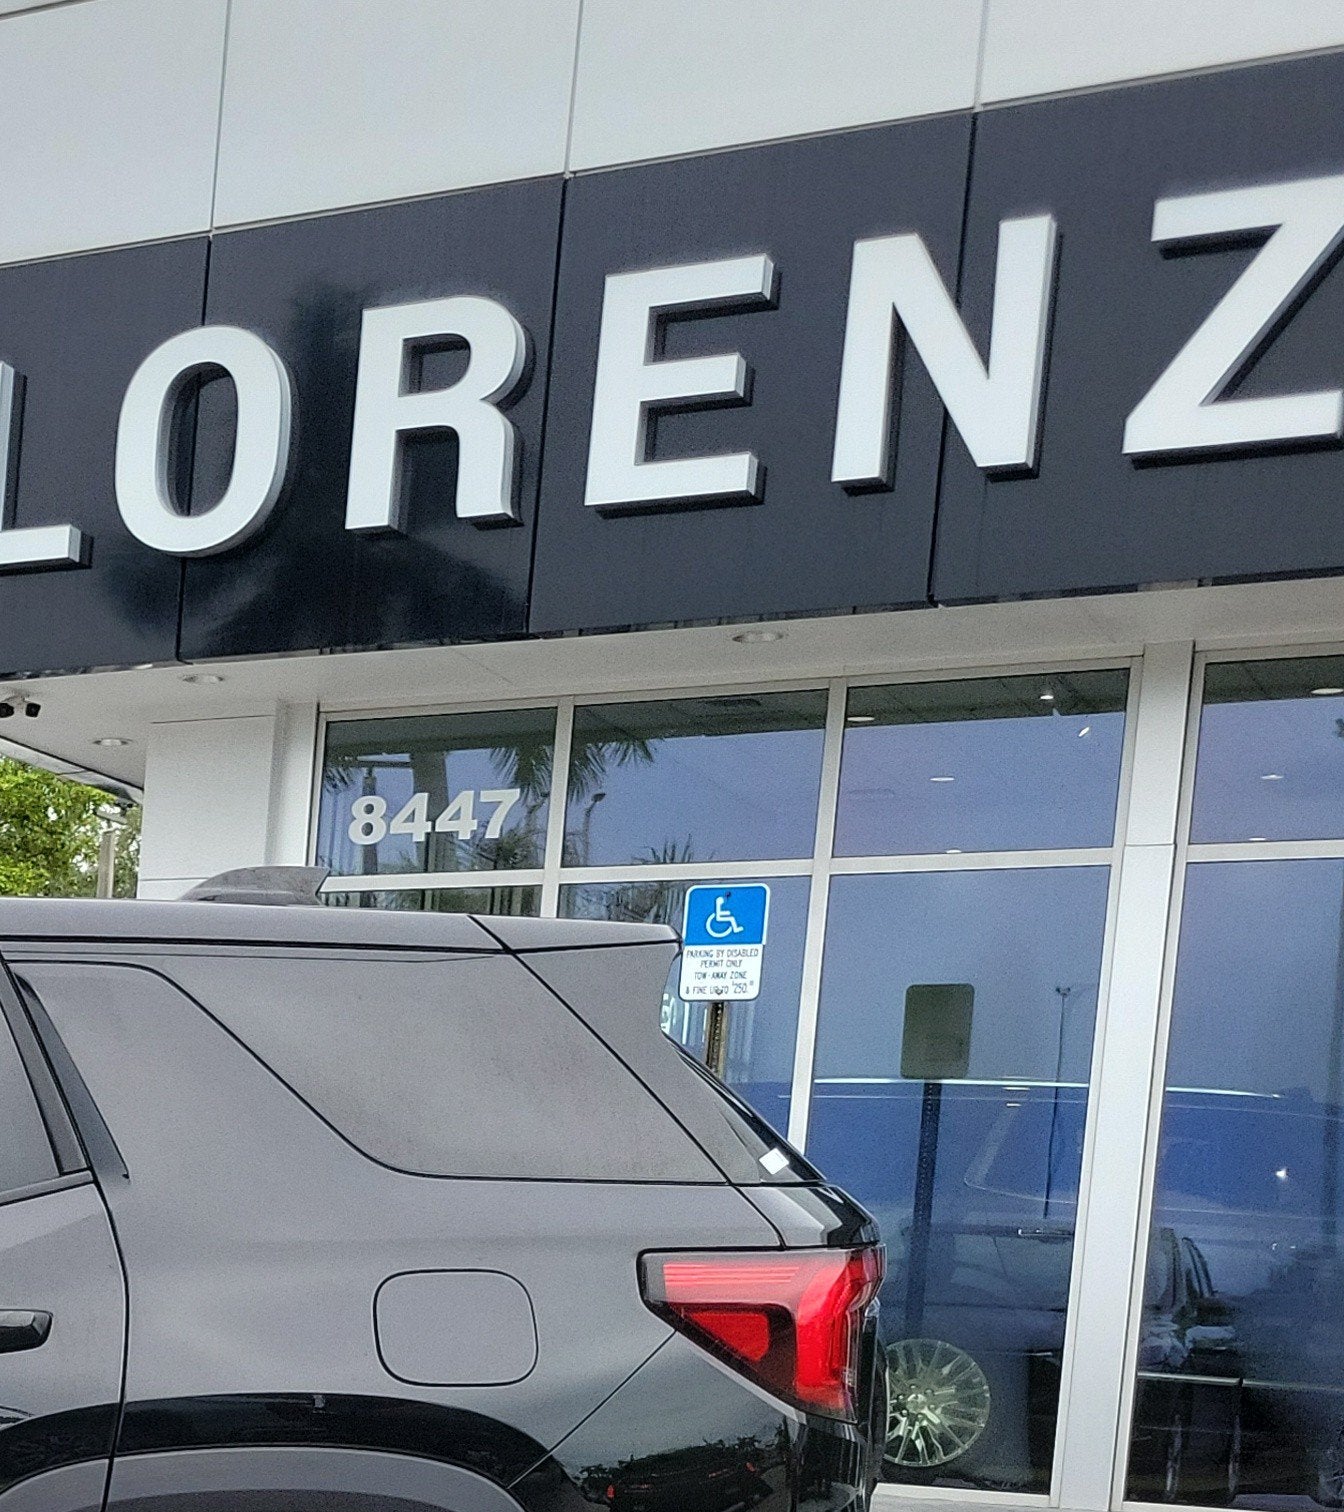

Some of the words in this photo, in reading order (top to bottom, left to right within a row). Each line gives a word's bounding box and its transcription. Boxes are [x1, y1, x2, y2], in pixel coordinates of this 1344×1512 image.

[348, 788, 520, 845] 8447
[686, 949, 714, 959] PARKING
[716, 949, 725, 958] BY
[726, 948, 759, 957] DISABLED
[700, 960, 724, 968] PERMIT
[726, 959, 743, 967] ONLY
[730, 970, 747, 979] ZONE
[693, 985, 708, 994] FINE
